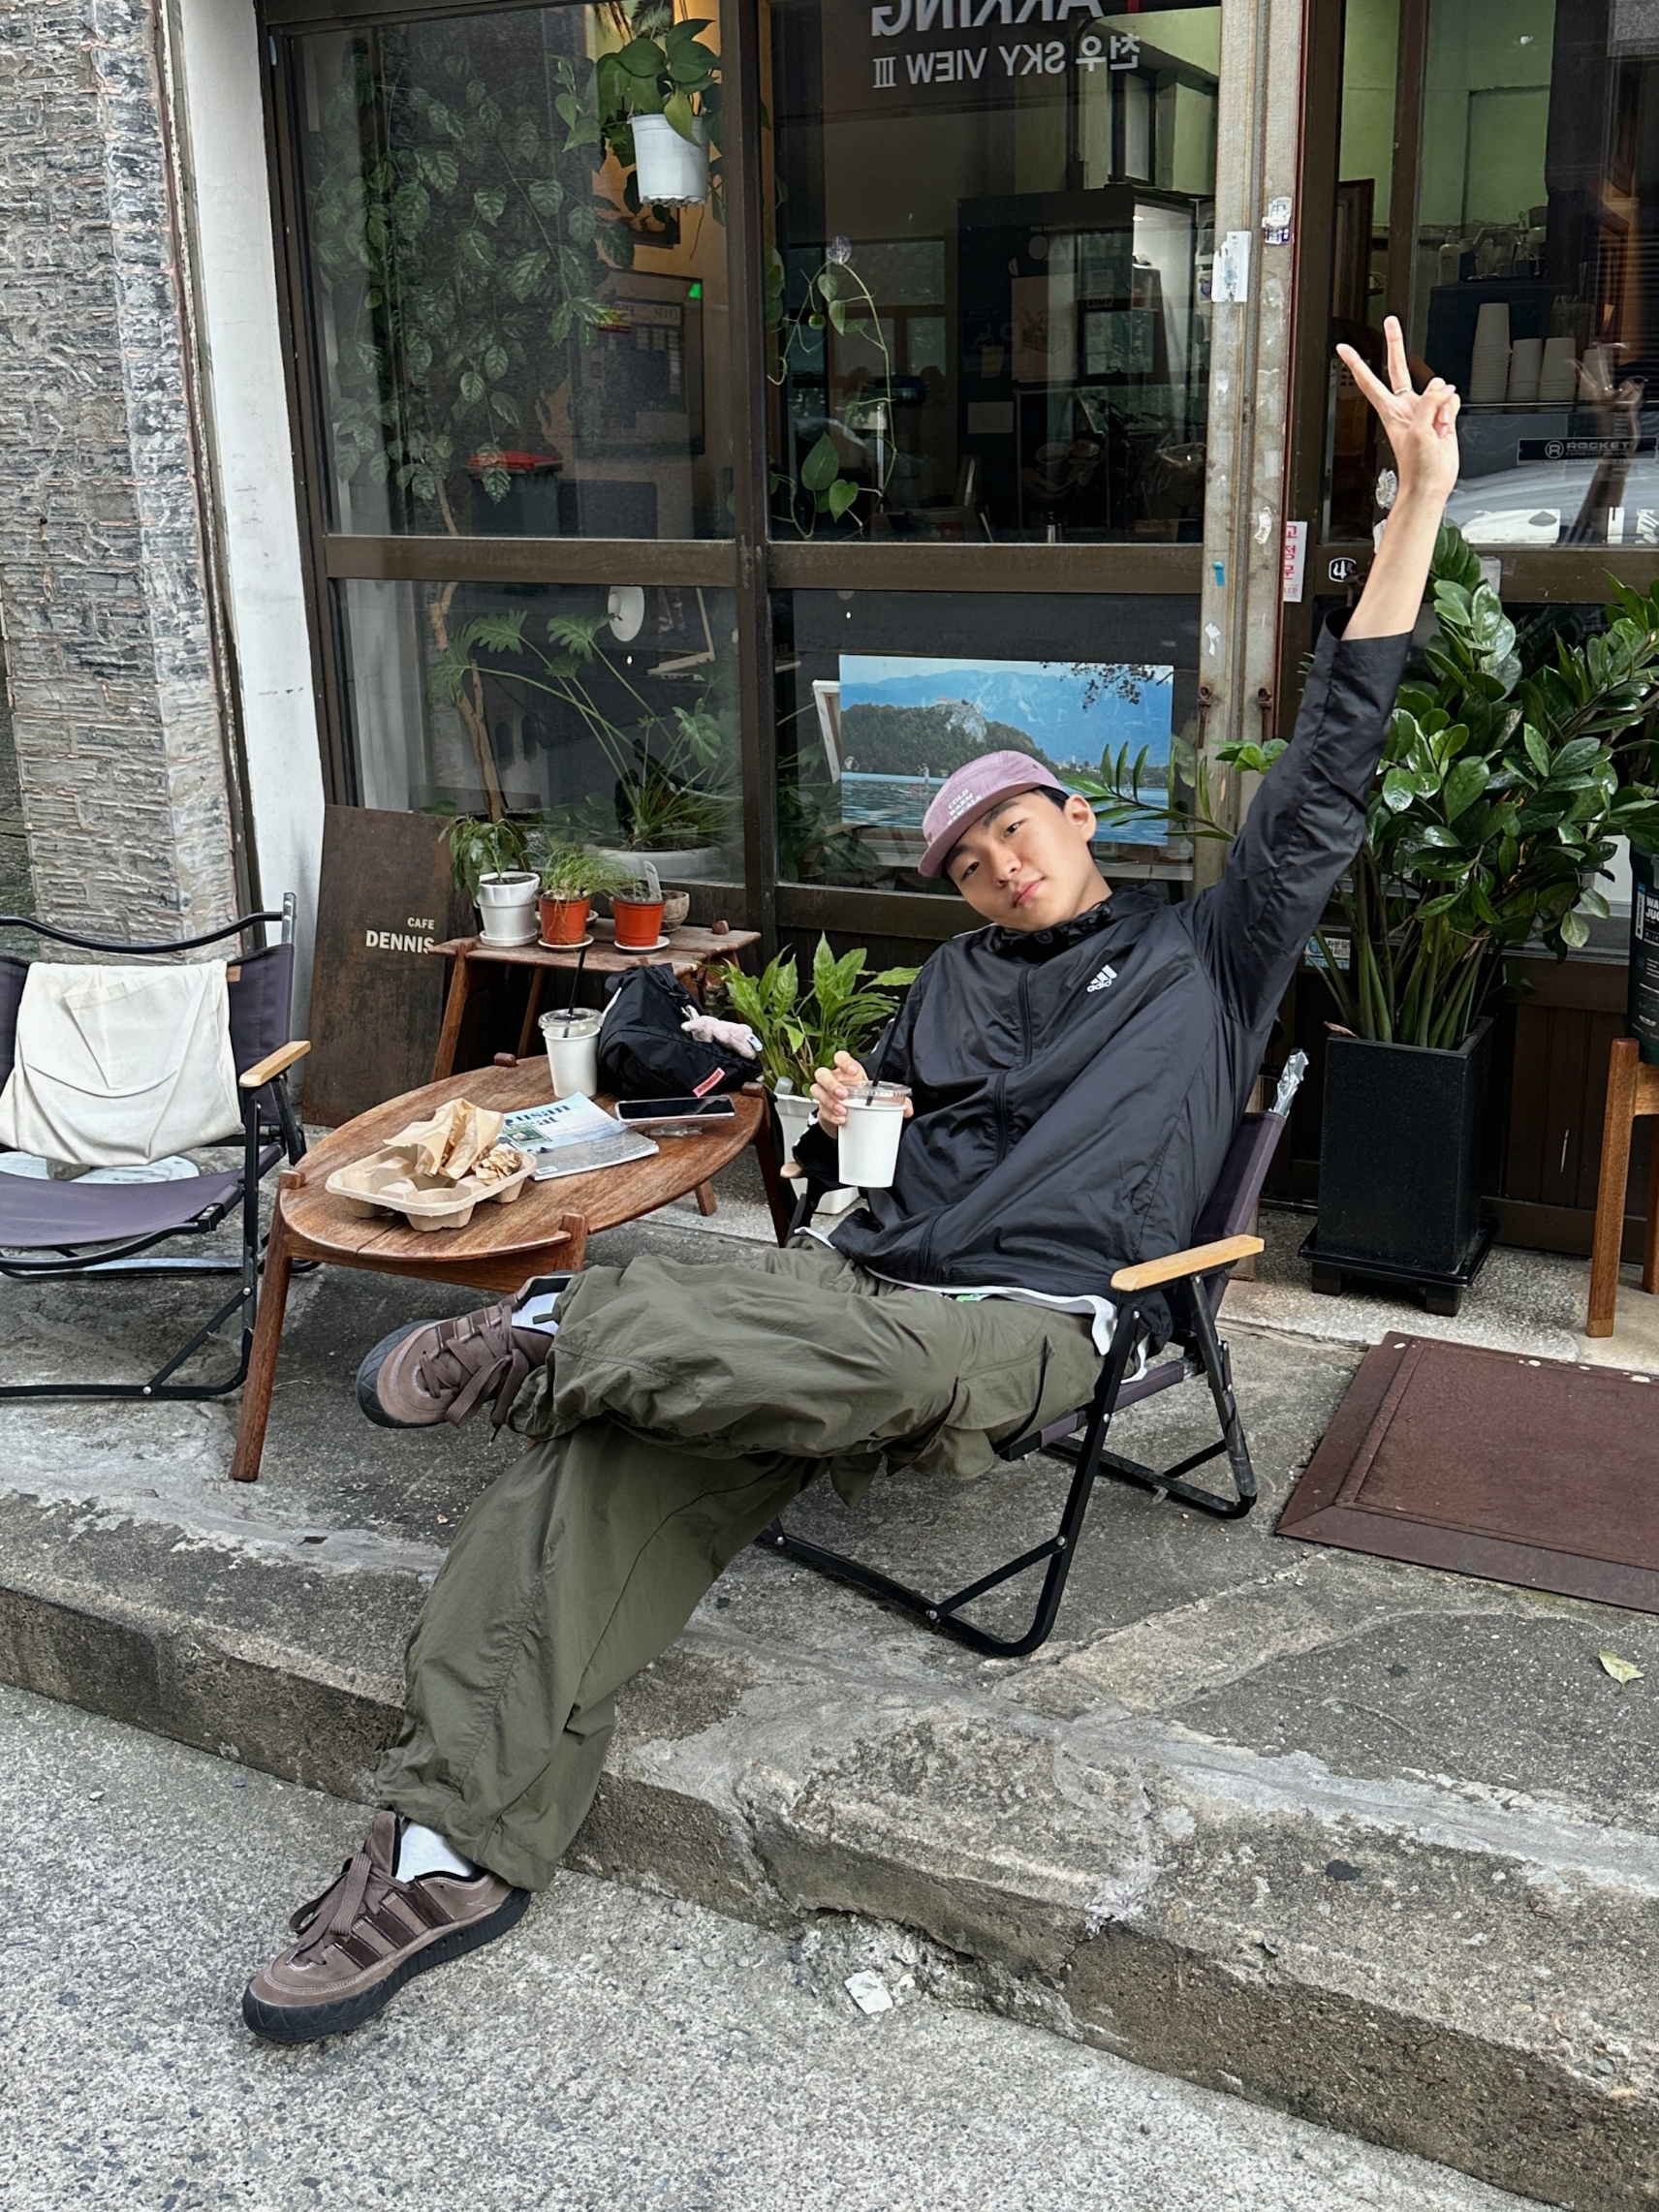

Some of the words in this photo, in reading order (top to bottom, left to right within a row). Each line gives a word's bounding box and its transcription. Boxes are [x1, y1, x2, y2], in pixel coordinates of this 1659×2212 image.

[1566, 441, 1630, 451] ROCKET
[948, 789, 969, 810] COLD
[407, 917, 435, 930] CAFE
[365, 929, 435, 954] DENNIS
